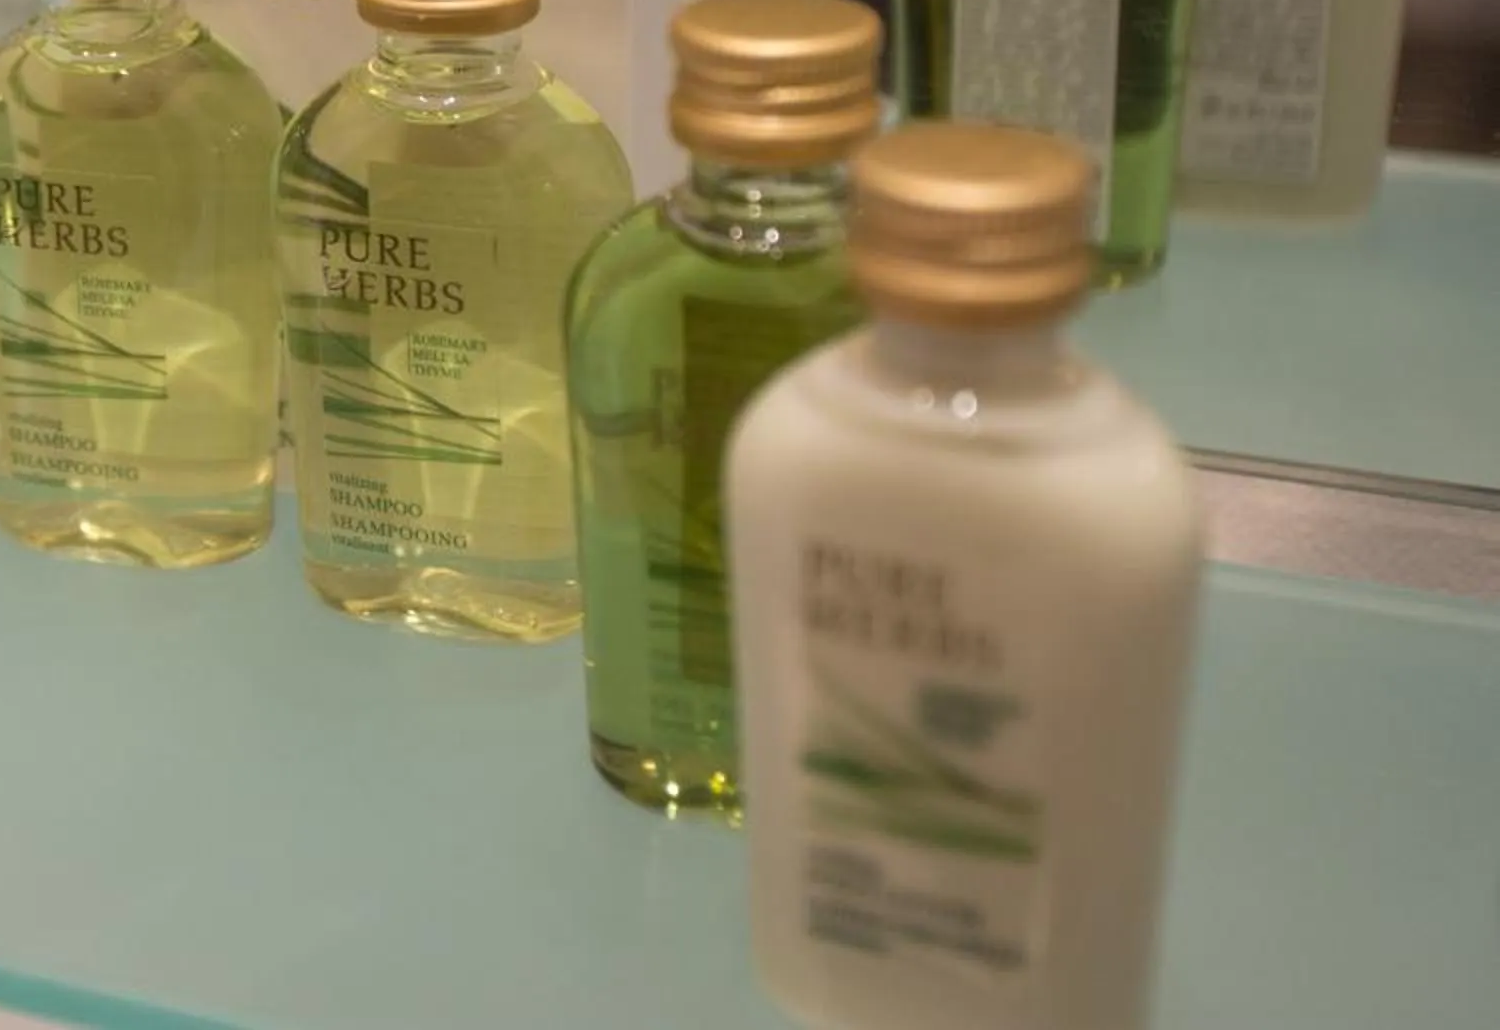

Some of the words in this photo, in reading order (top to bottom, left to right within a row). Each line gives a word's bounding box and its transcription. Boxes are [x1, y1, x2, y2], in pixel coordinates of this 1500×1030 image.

[319, 226, 431, 272] PURE
[322, 263, 466, 315] HERBS
[411, 333, 487, 353] ROSEMARY
[8, 426, 98, 452] SHAMPOO
[10, 448, 140, 482] SHAMPOOING
[329, 486, 424, 518] SHAMPOO
[330, 511, 468, 550] SHAMPOOING
